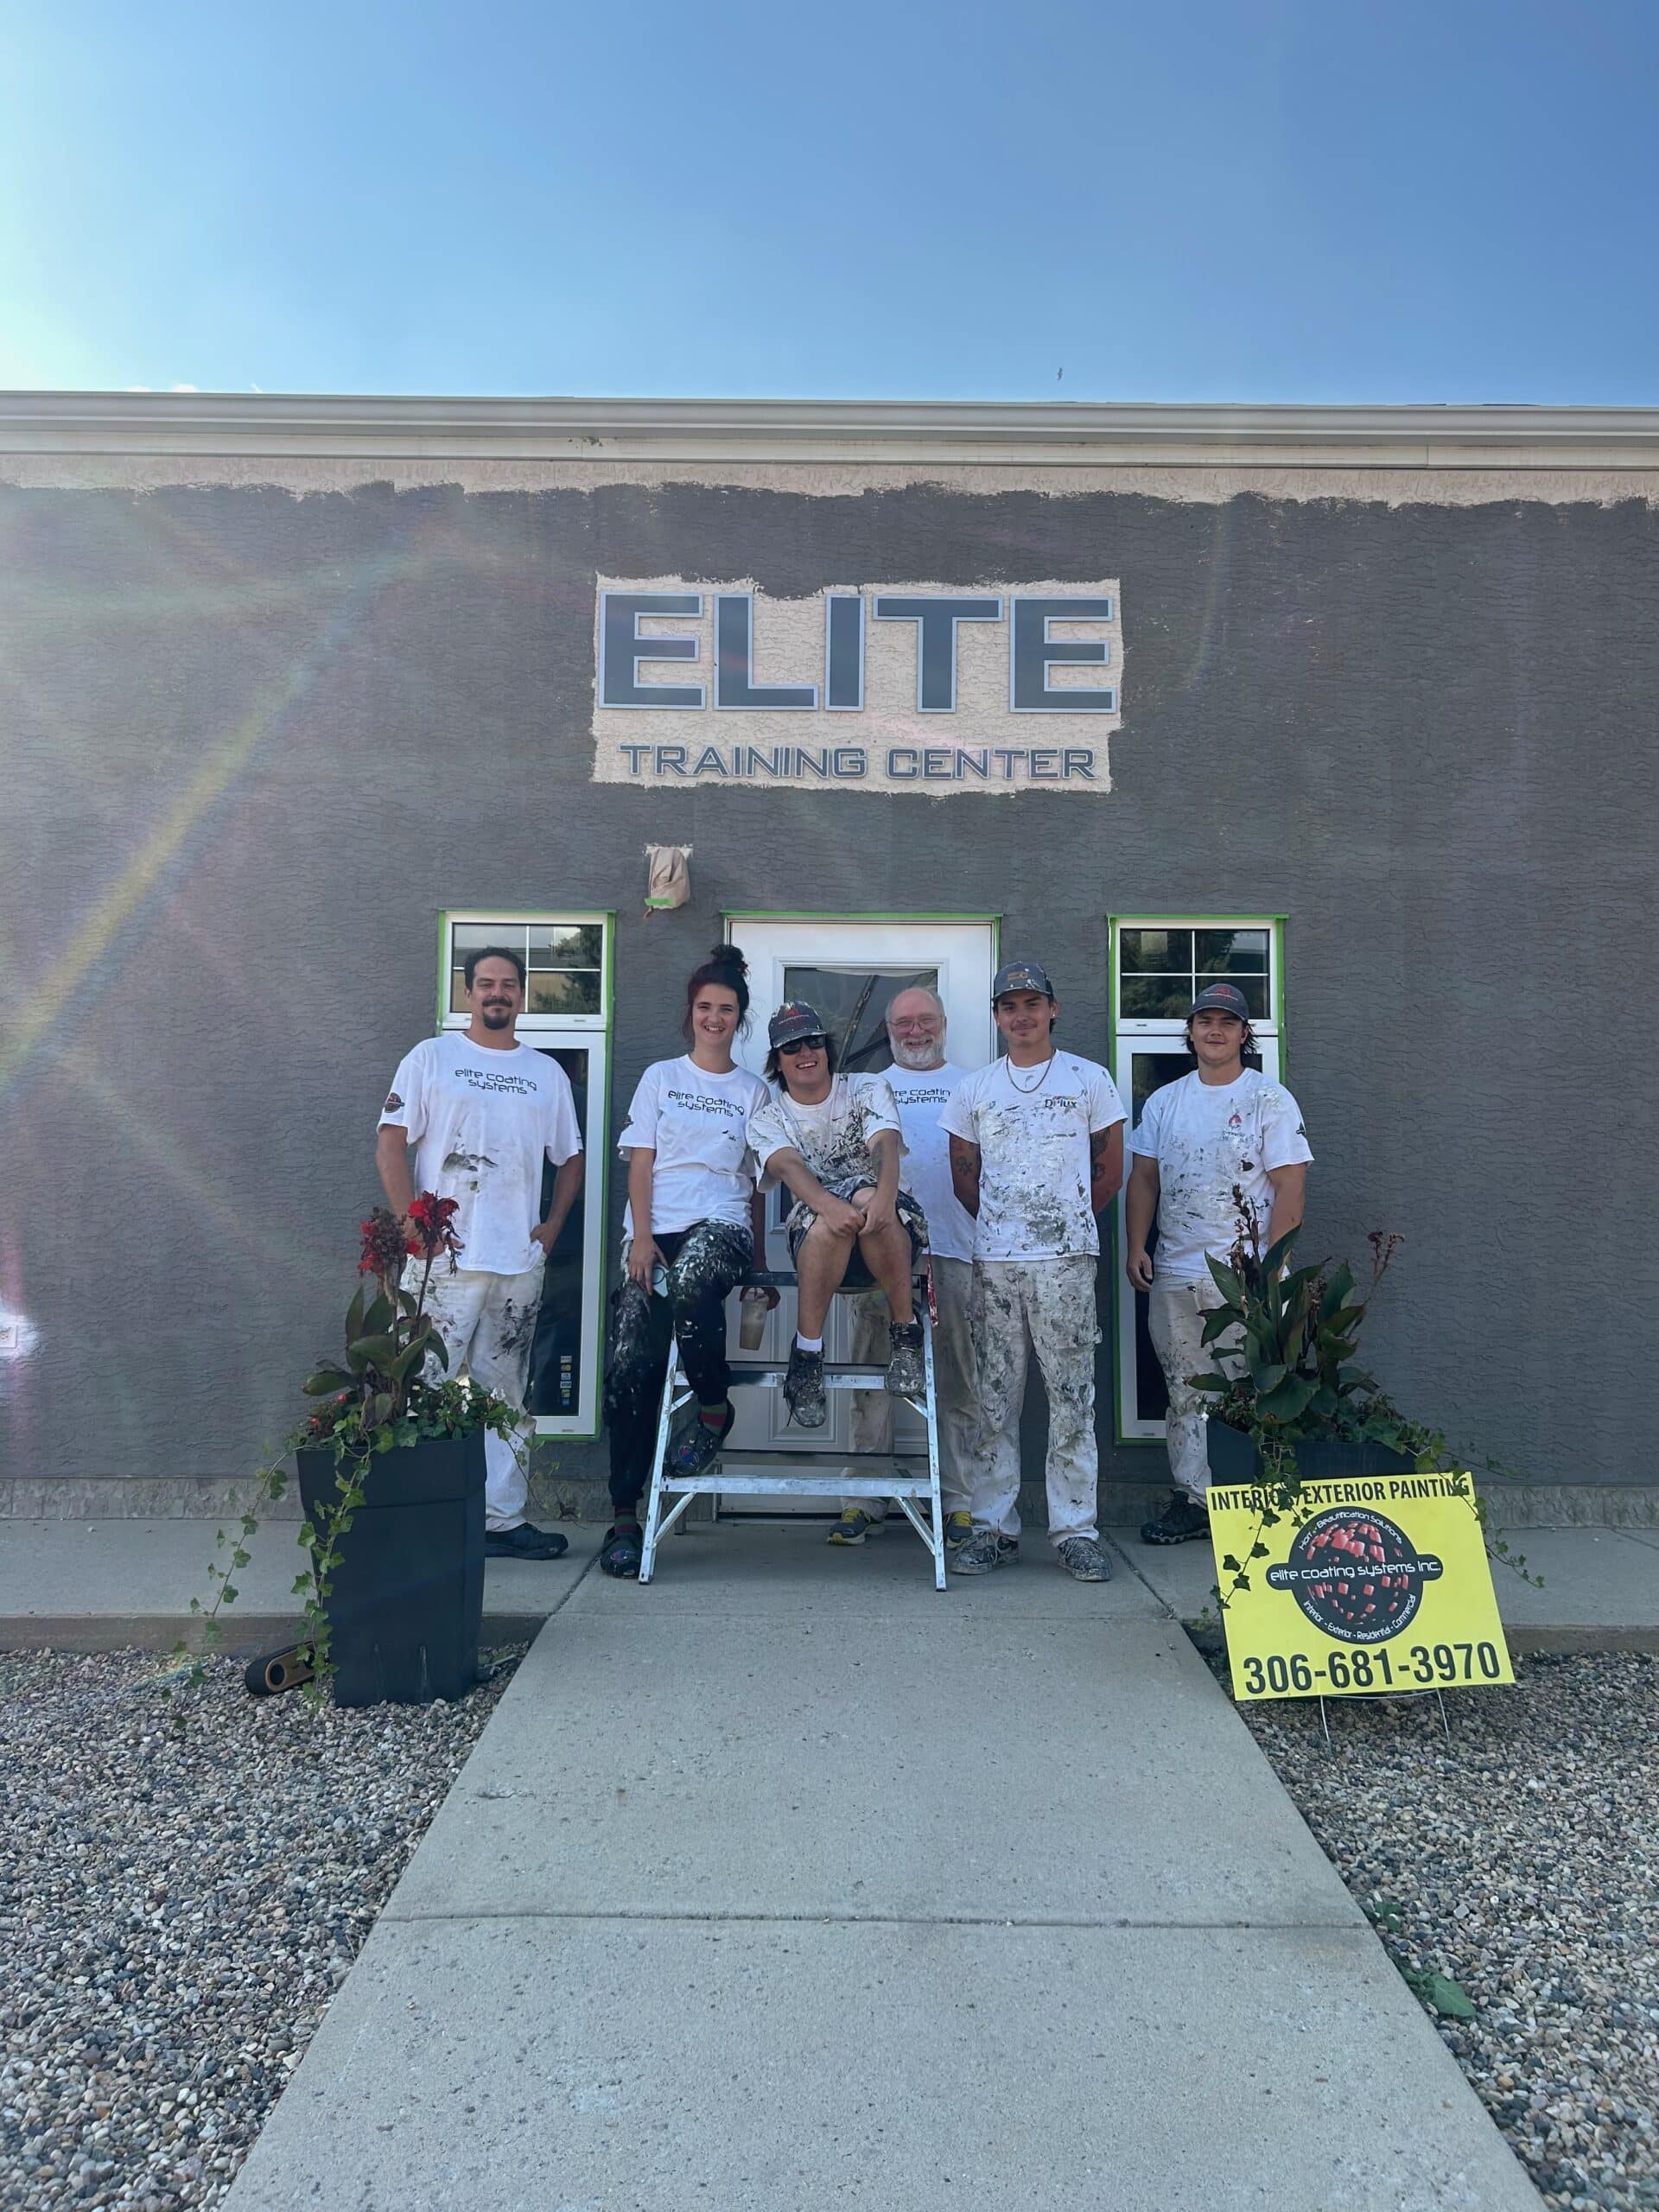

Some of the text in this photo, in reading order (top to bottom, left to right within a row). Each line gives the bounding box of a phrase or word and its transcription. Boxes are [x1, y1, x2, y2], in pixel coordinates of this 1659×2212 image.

[599, 590, 1116, 714] ELITE
[619, 745, 1097, 780] TRAINING CENTER
[454, 1068, 537, 1091] elite coating
[468, 1079, 528, 1095] systems
[667, 1090, 745, 1116] elite coating
[893, 1096, 948, 1105] systems
[910, 1088, 950, 1096] coatin
[677, 1101, 734, 1117] systems
[1389, 1478, 1471, 1499] PAINTING
[1316, 1511, 1370, 1529] Beautification
[1370, 1515, 1402, 1545] Solutions
[1270, 1568, 1299, 1581] elite
[1301, 1565, 1355, 1579] coating
[1357, 1562, 1416, 1577] systems
[1303, 1599, 1325, 1623] Interior
[1328, 1622, 1352, 1639] Exterior
[1357, 1625, 1391, 1641] Residential
[1391, 1592, 1417, 1629] Commercial
[1243, 1642, 1501, 1694] 306-681-3970
